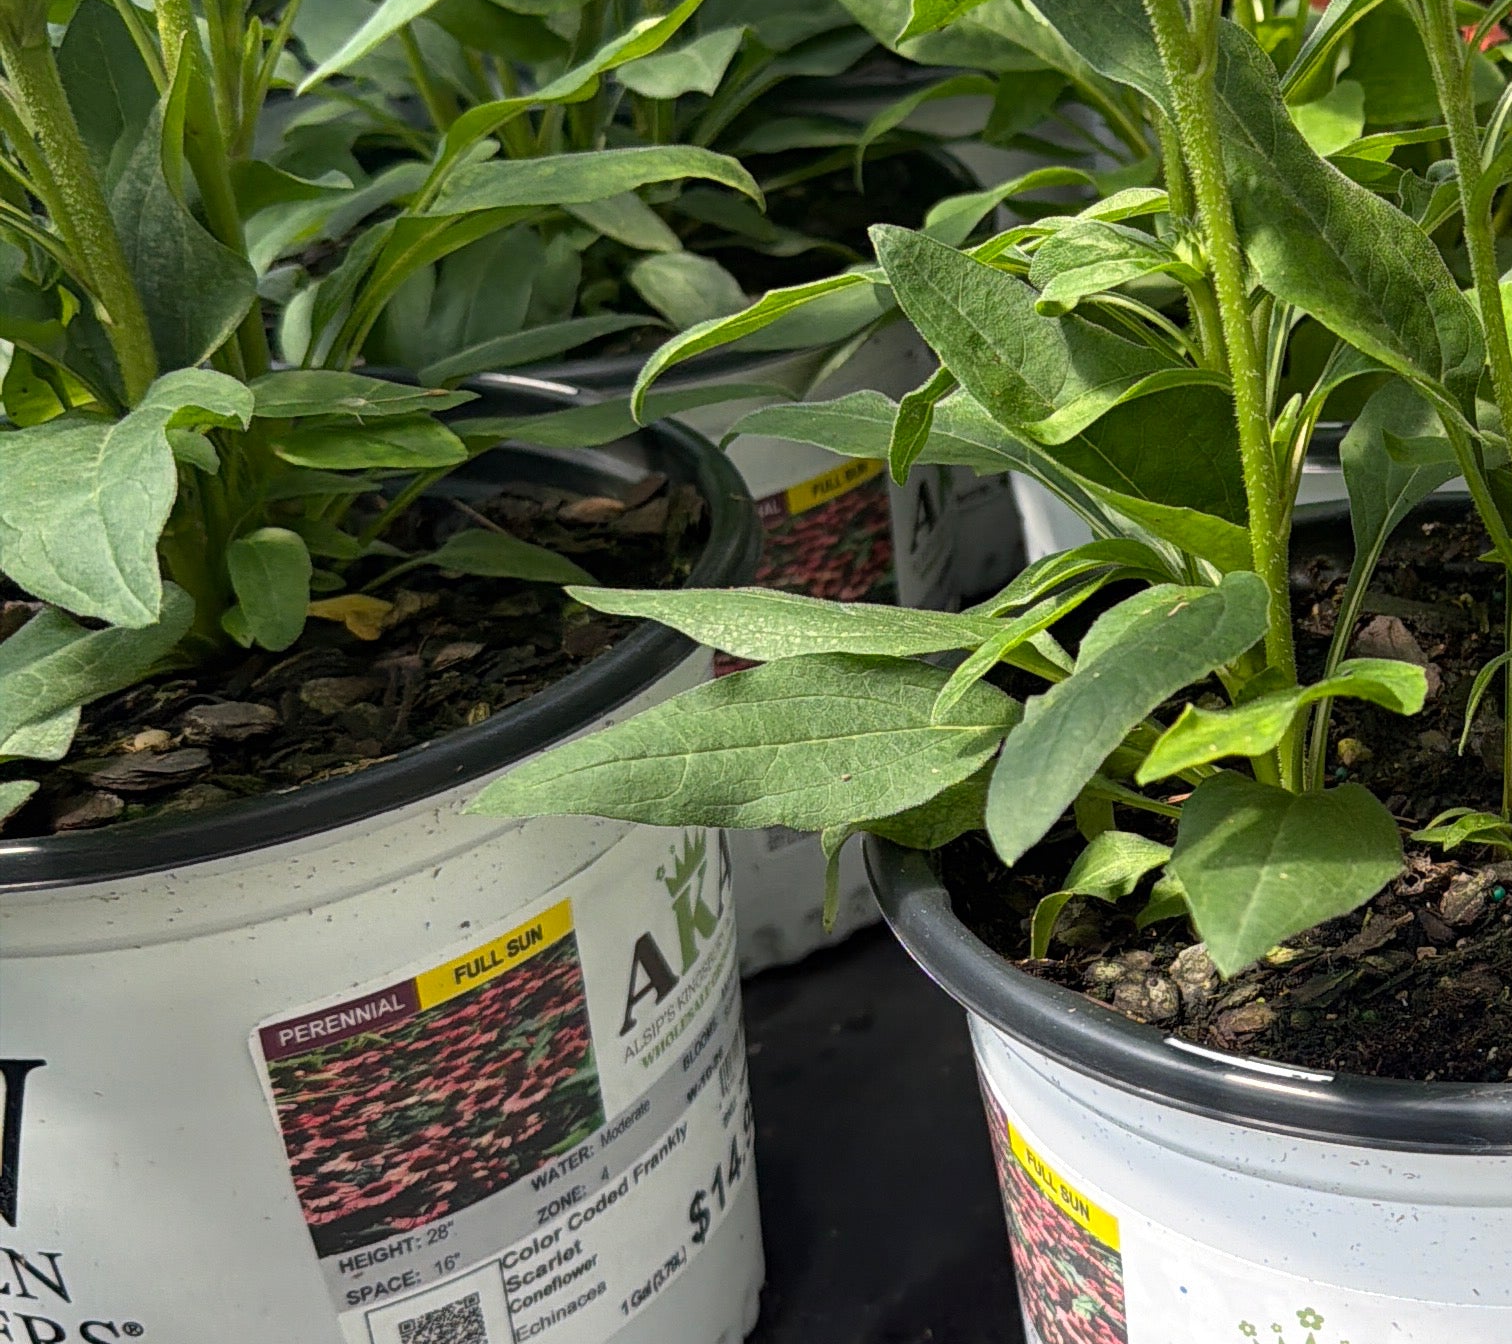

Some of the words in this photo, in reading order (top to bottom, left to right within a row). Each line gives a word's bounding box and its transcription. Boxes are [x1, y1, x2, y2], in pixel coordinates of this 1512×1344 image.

[279, 993, 406, 1047] PERENNIAL
[453, 949, 504, 985] FULL
[506, 923, 543, 958] SUN
[531, 1144, 594, 1192] WATER:
[600, 1099, 651, 1147] Moderate
[502, 1227, 563, 1270] Color
[567, 1177, 629, 1232] Coded
[632, 1120, 689, 1184] Frankly
[536, 1183, 587, 1225] ZONE:
[1025, 1147, 1058, 1194] FULL
[1059, 1183, 1091, 1222] SUN
[338, 1233, 422, 1275] HEIGHT:
[427, 1220, 454, 1246] 28"
[346, 1268, 421, 1306] SPACE:
[433, 1251, 461, 1276] 16"
[505, 1238, 584, 1293] Scarlet
[509, 1253, 599, 1314] Coneflower
[516, 1280, 608, 1344] Echinacea
